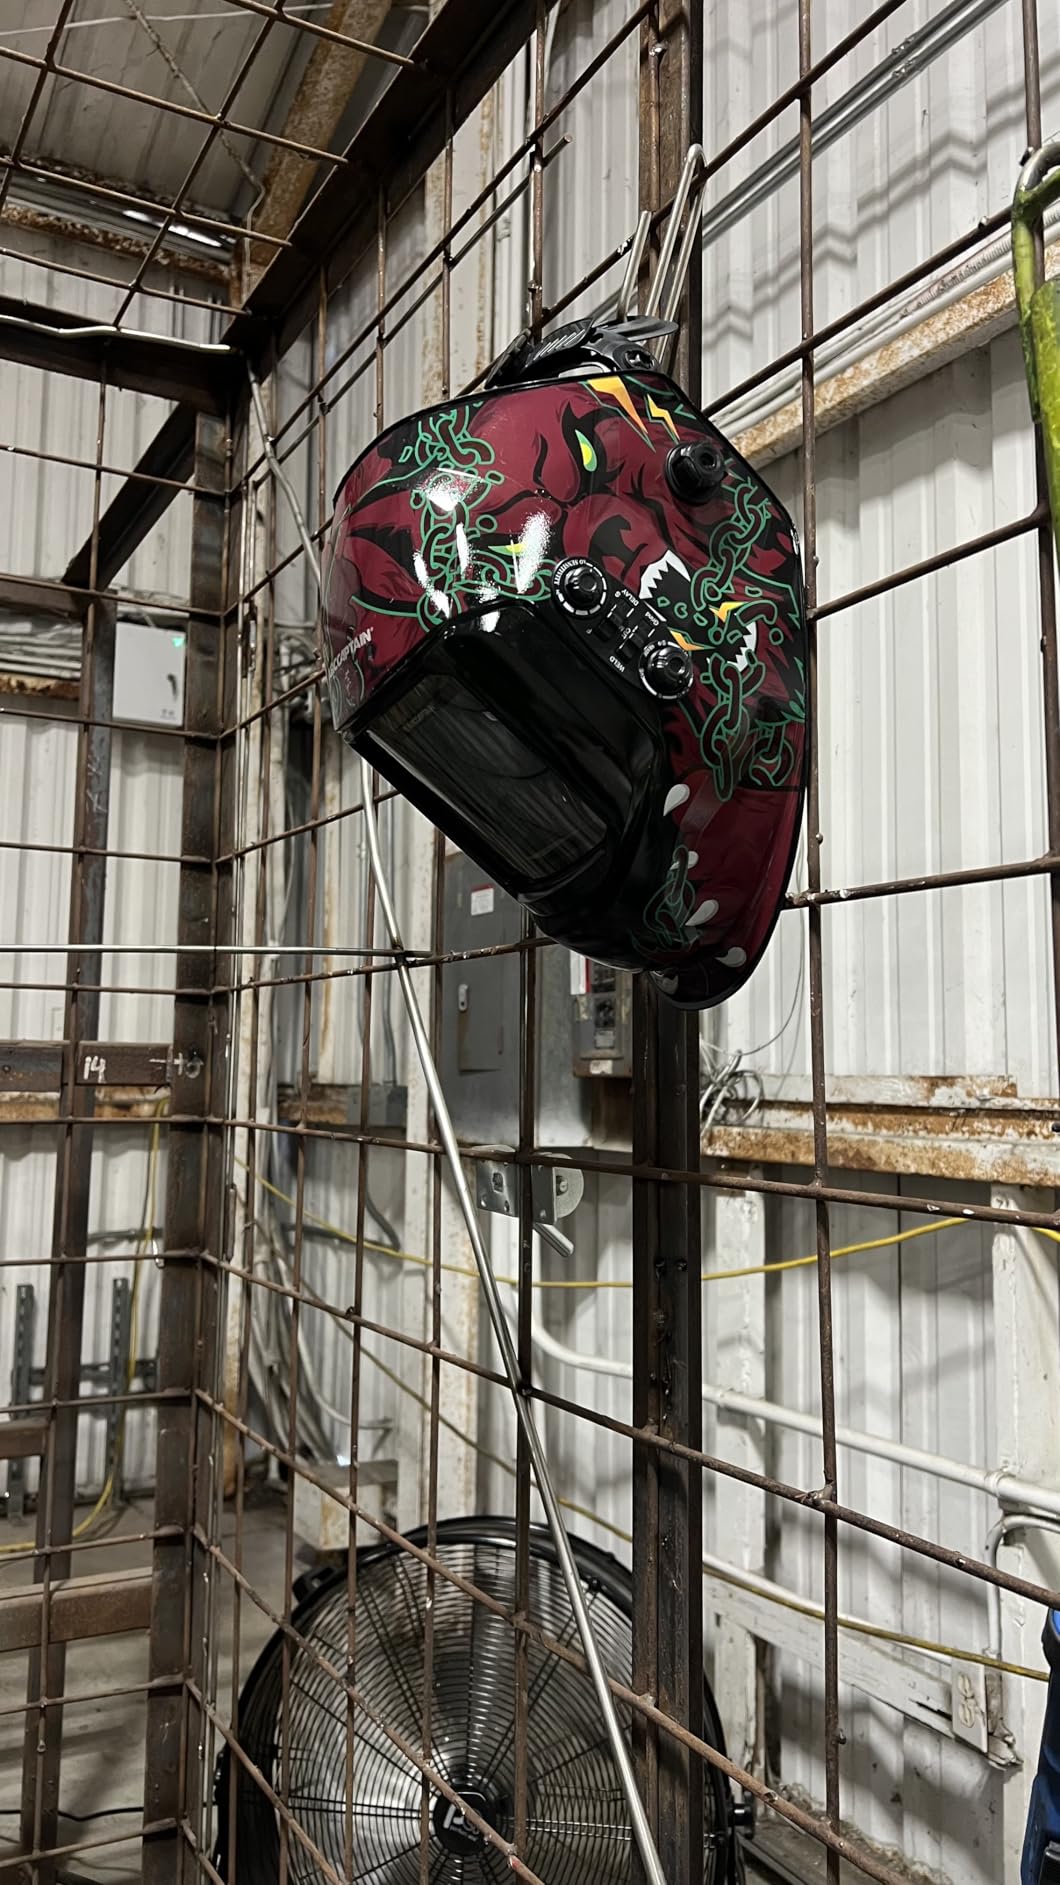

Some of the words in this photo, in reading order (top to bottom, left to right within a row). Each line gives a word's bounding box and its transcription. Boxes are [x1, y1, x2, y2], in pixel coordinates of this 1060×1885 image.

[621, 589, 639, 606] DELAY
[645, 611, 660, 626] Grind
[609, 655, 625, 673] WELD
[83, 1056, 107, 1083] 14
